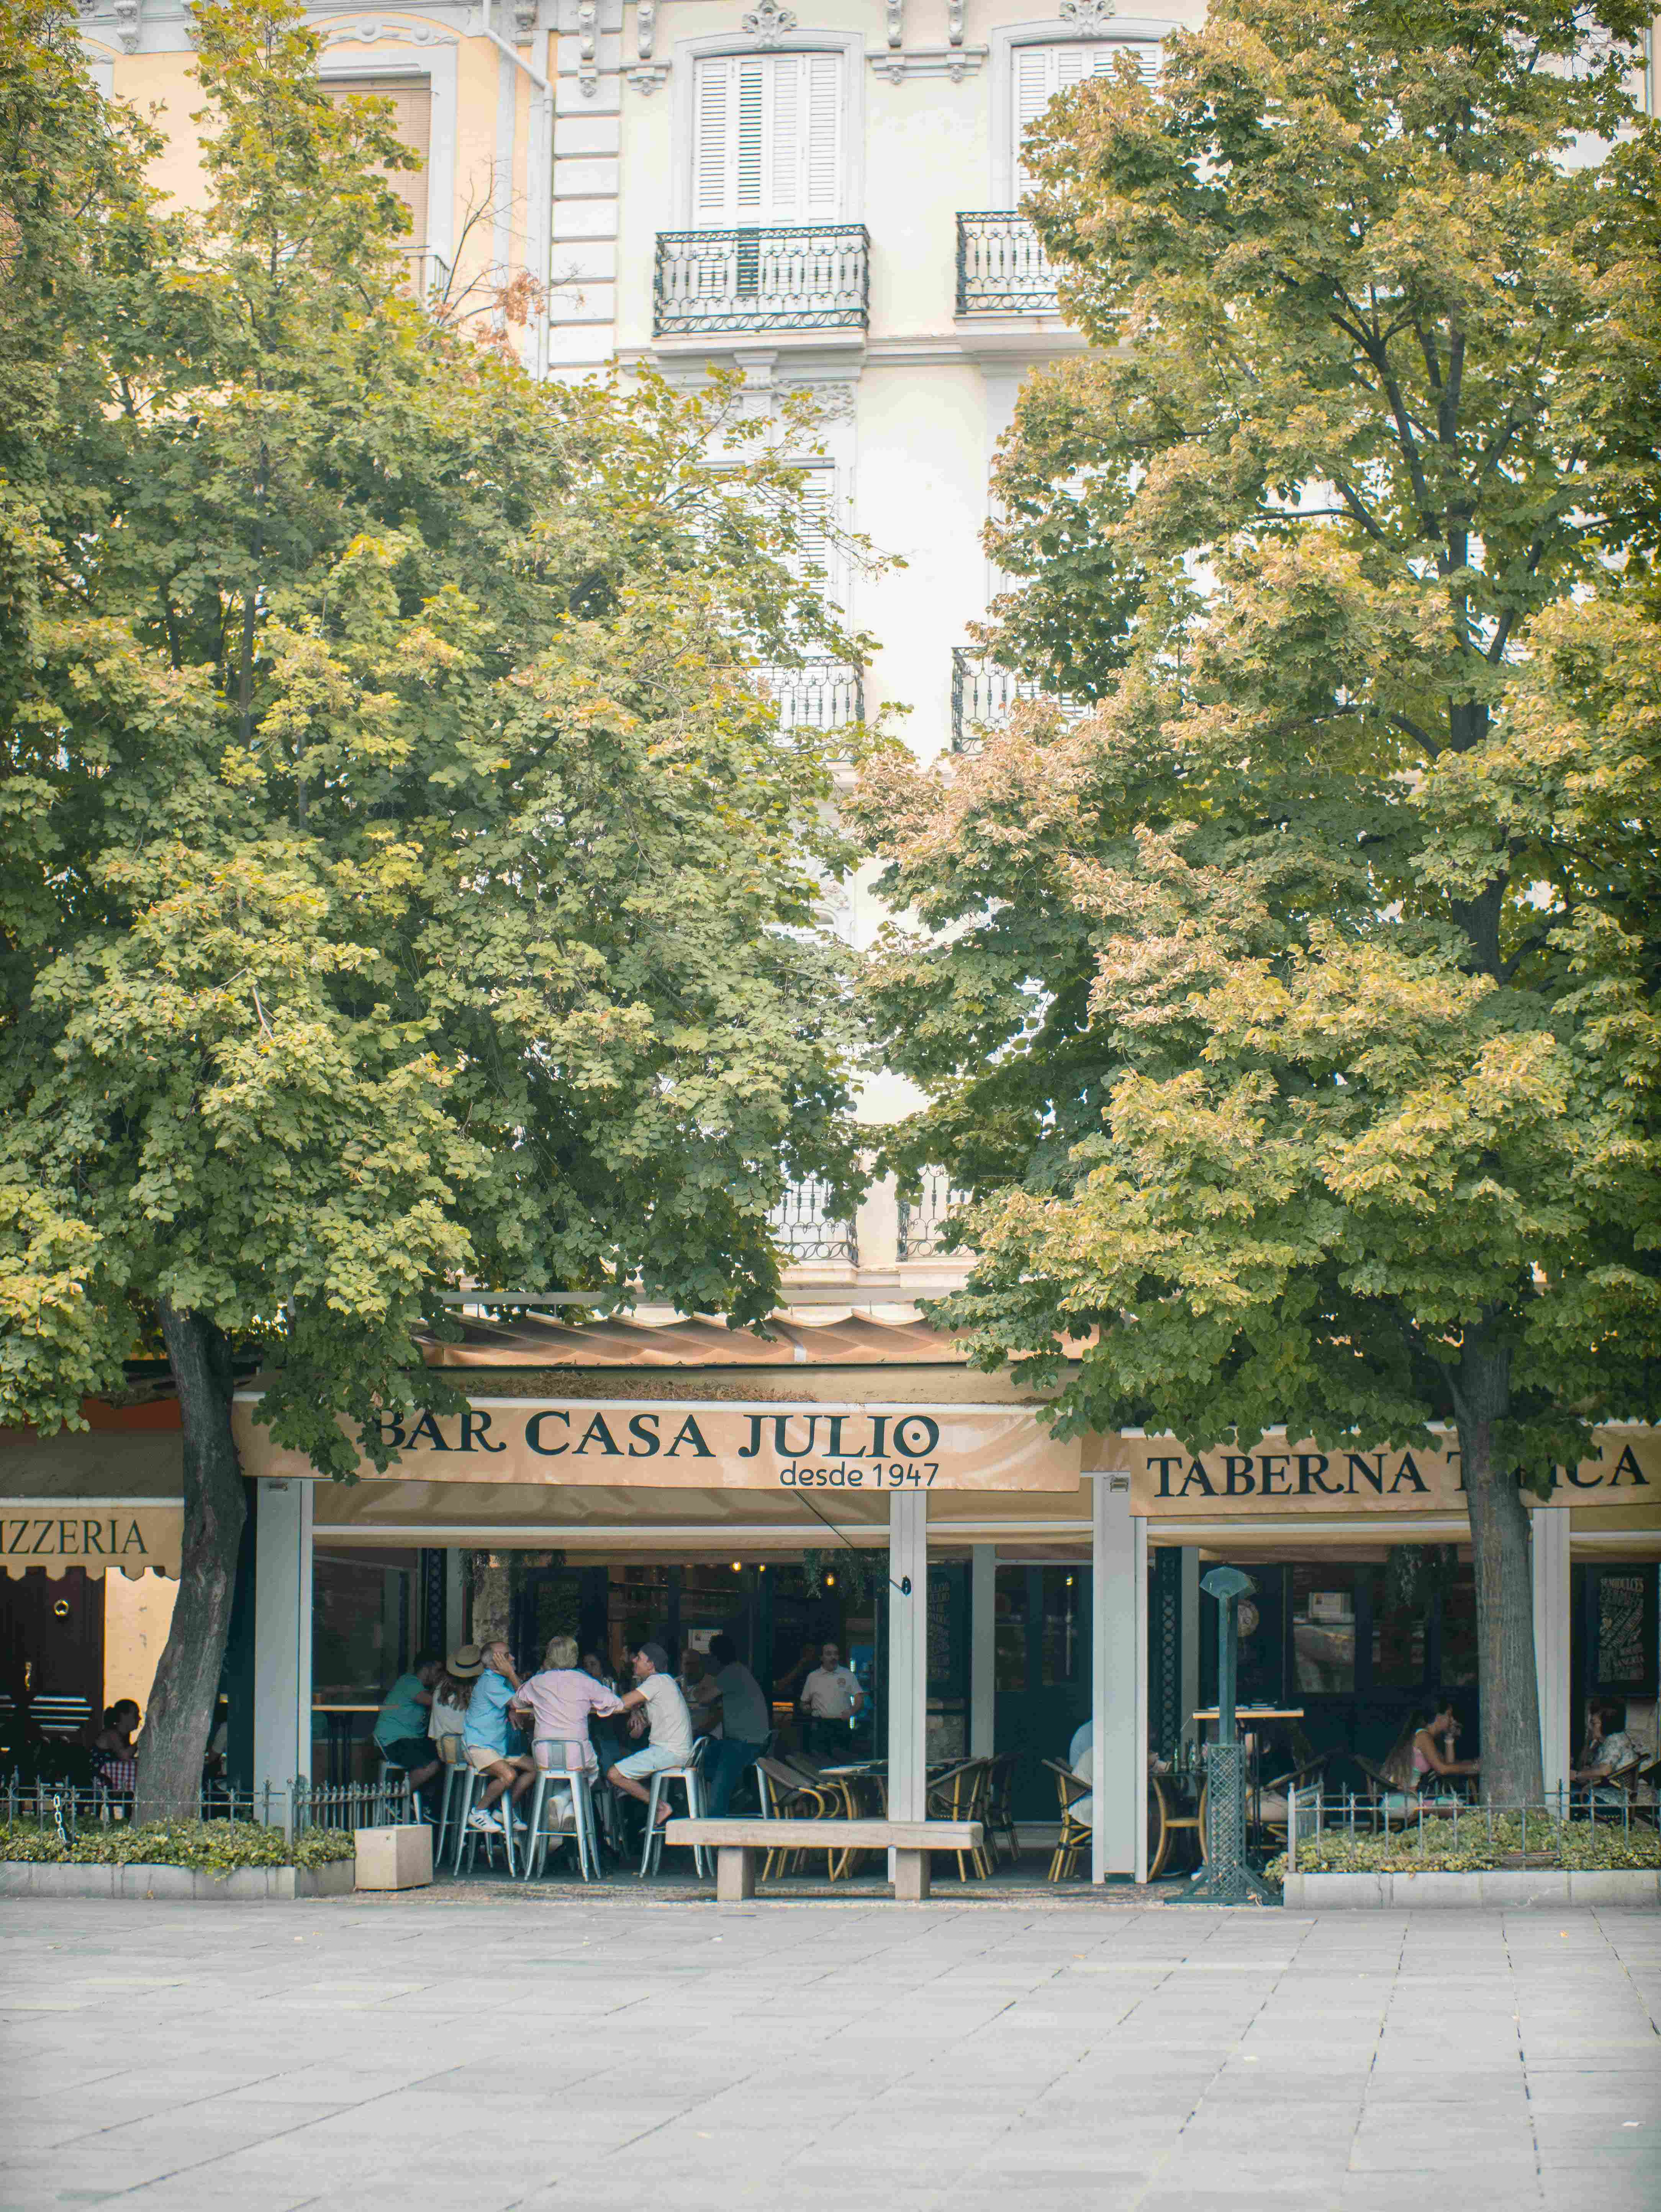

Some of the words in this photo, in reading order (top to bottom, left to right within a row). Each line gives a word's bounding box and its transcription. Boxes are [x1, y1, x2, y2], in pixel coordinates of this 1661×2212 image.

[366, 1408, 507, 1452] BAR
[525, 1410, 716, 1457] CASA
[738, 1414, 939, 1458] JULIO
[780, 1461, 863, 1487] desde
[872, 1463, 939, 1487] 1947
[1147, 1451, 1432, 1498] TABERNA
